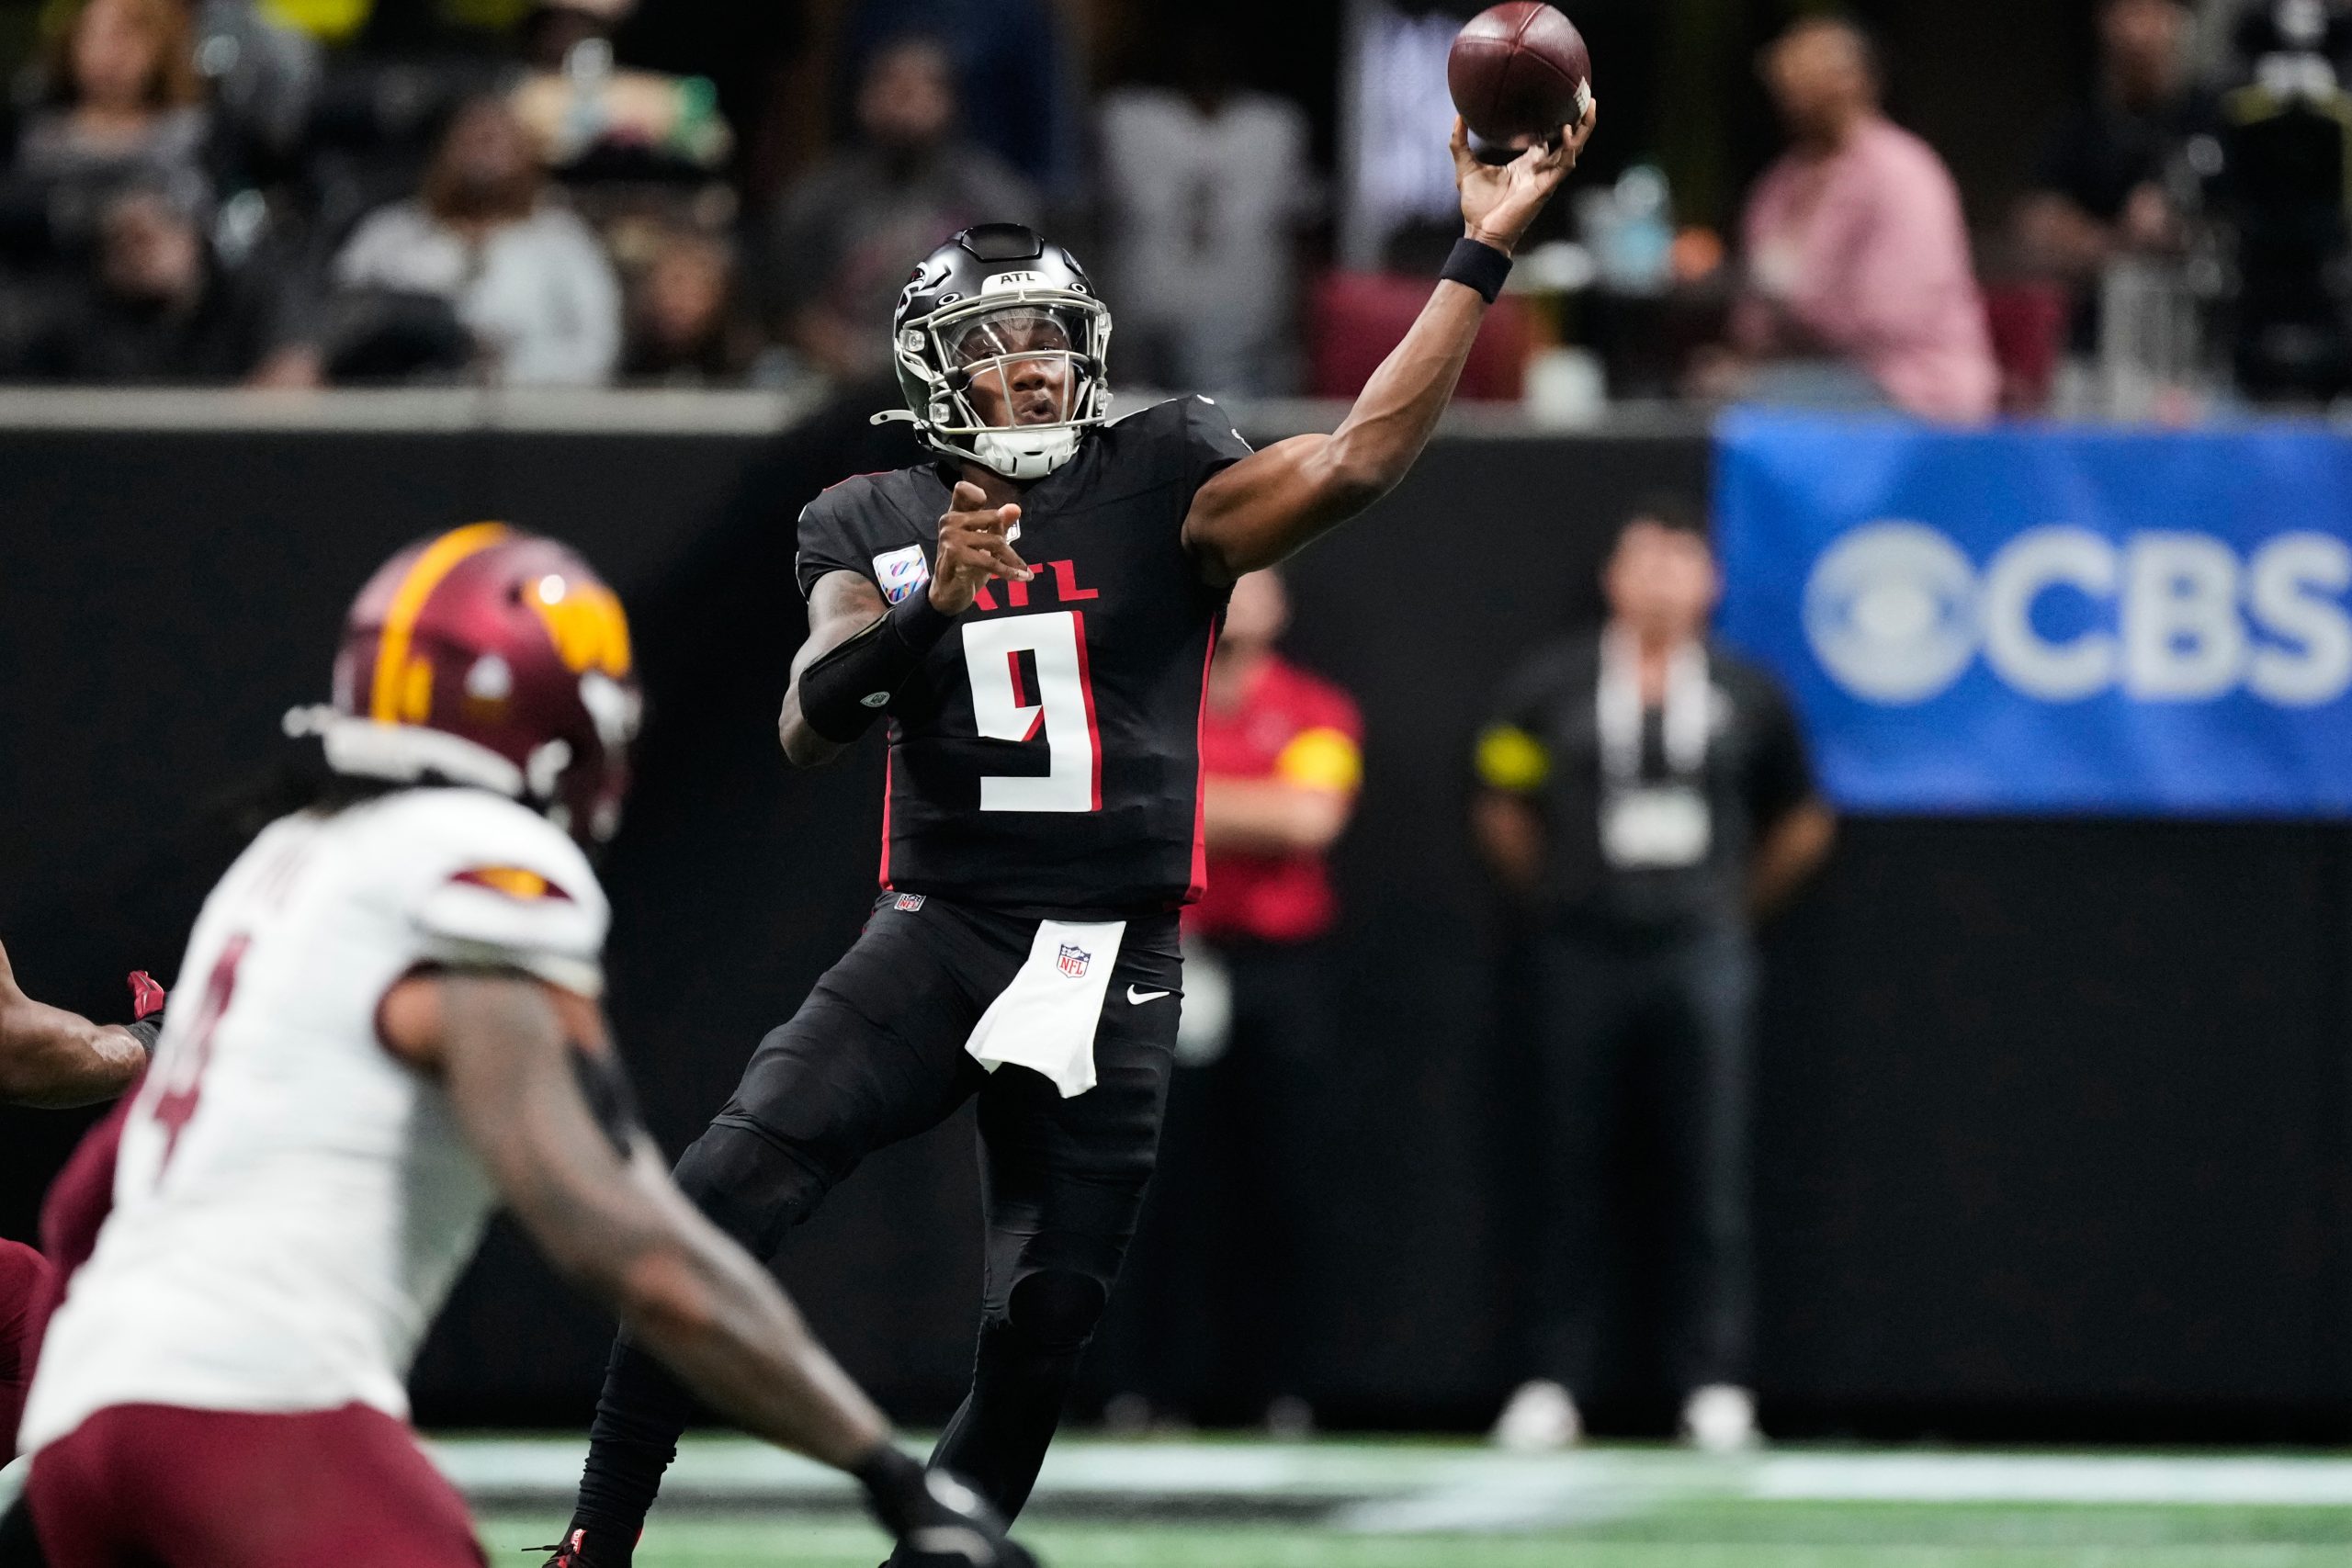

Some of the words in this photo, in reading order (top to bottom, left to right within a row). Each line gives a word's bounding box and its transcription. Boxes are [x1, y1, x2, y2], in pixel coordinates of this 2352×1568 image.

[1001, 273, 1035, 285] ATL
[1983, 524, 2352, 707] CBS
[962, 611, 1102, 812] 9
[899, 899, 919, 908] NFL
[1059, 957, 1083, 976] NFL
